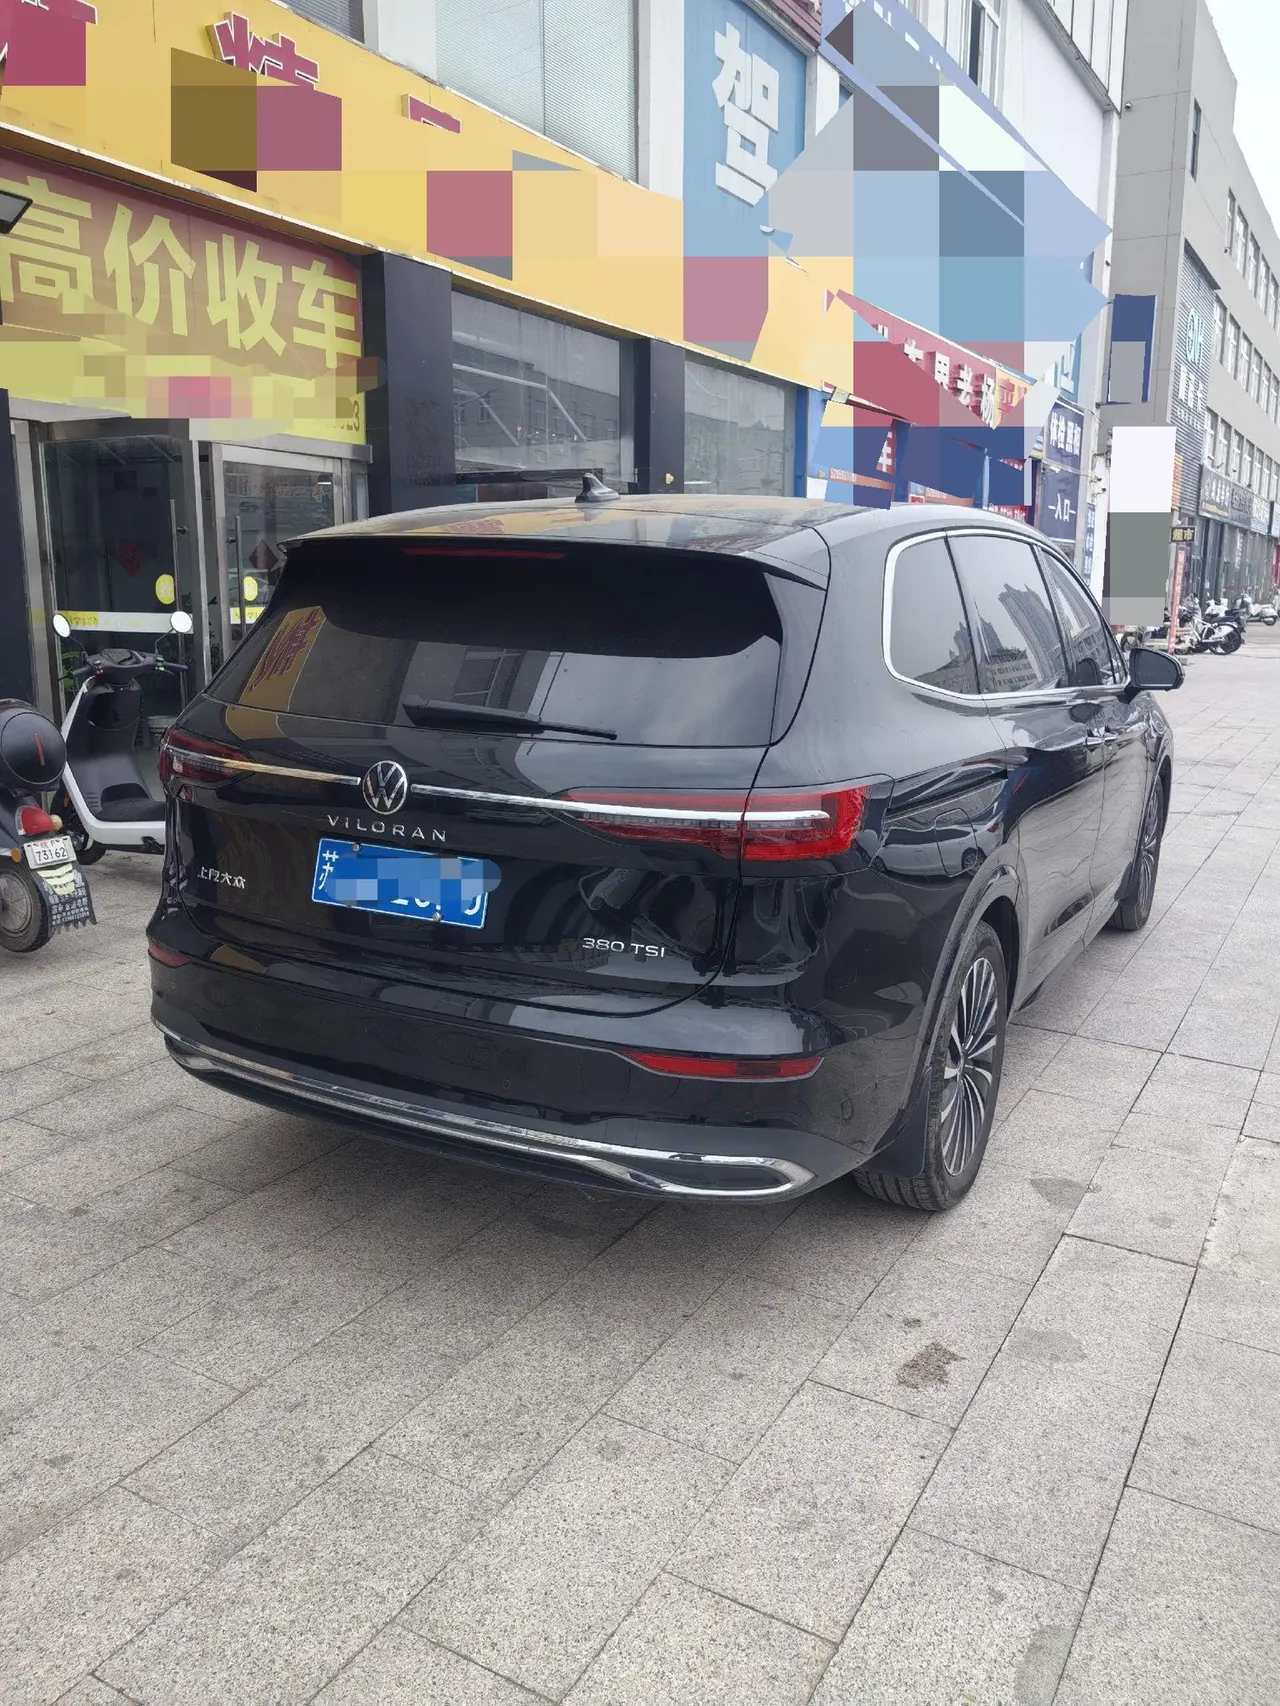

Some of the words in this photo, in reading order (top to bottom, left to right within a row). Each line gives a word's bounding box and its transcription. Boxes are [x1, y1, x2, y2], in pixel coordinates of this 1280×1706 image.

[0, 175, 359, 370] 高价收车
[1173, 528, 1194, 541] 超市
[327, 814, 446, 842] VILORAN
[36, 847, 67, 862] 73162
[197, 866, 246, 889] 上汽大众
[582, 937, 625, 953] 380
[630, 943, 665, 958] TSI
